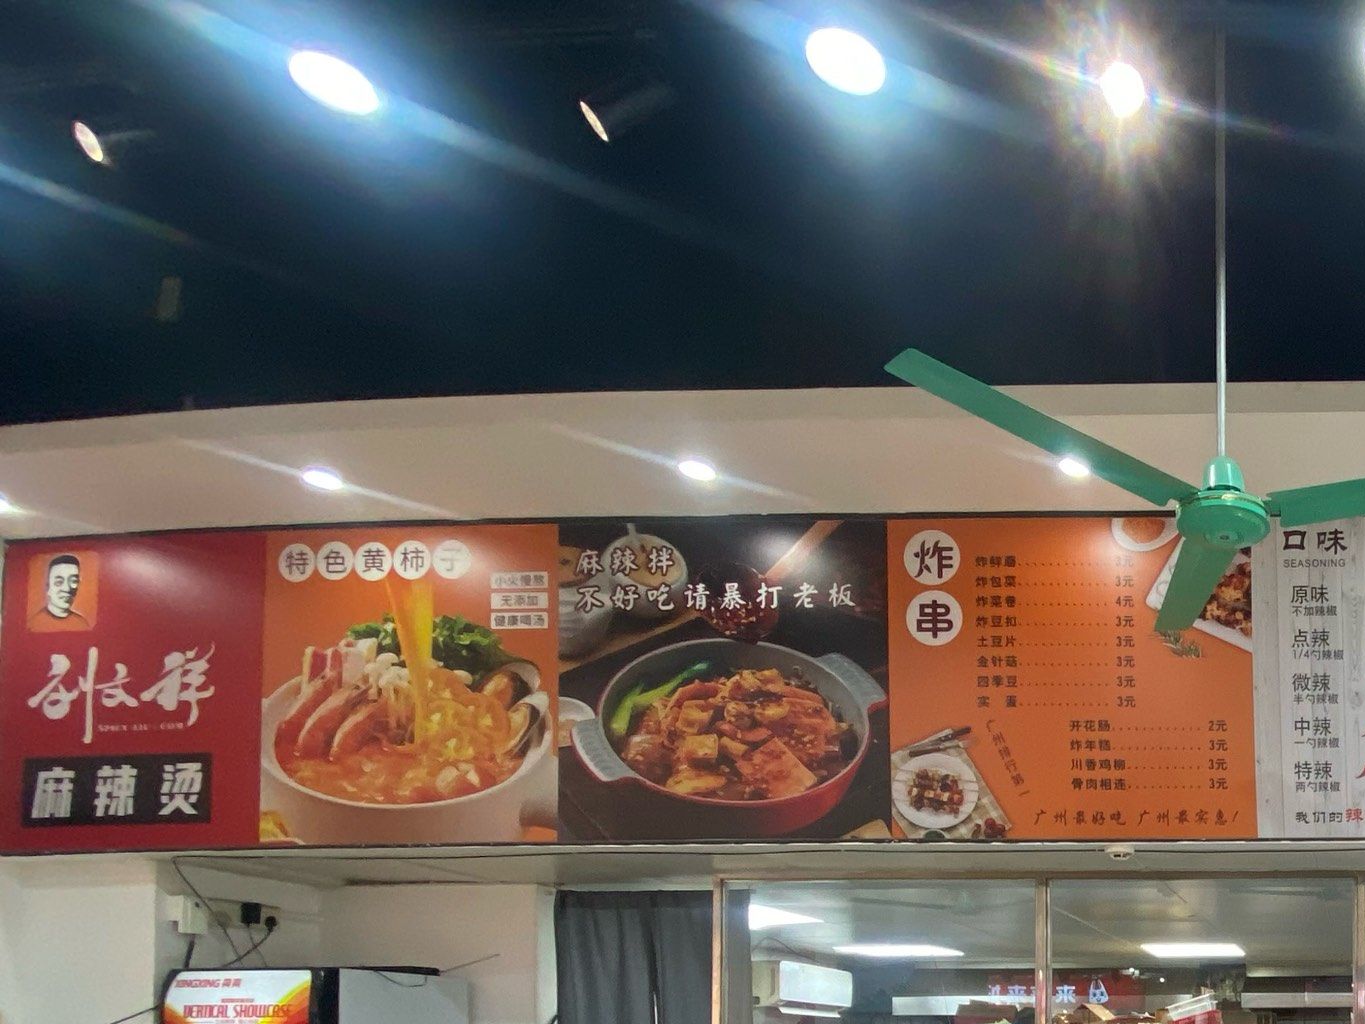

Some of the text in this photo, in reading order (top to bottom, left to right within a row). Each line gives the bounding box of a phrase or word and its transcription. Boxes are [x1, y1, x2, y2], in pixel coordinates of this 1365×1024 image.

[1282, 529, 1348, 555] 口味
[284, 544, 465, 575] 特色黄柿子
[576, 549, 675, 576] 麻辣拌
[1283, 558, 1346, 568] SEASONING
[1115, 576, 1134, 588] 3元
[576, 582, 856, 612] 不好吃请暴打老板
[1291, 584, 1329, 604] 原味
[1115, 596, 1134, 608] 4元
[1291, 605, 1337, 617] 不加辣椒
[1115, 616, 1134, 628] 3元
[977, 636, 1135, 648] 土豆片 3元
[1291, 628, 1331, 648] 点辣
[1292, 649, 1344, 660] 1/4勺辣椒
[977, 656, 1135, 668] 金针菇 3元
[1116, 676, 1136, 688] 3元
[1291, 672, 1331, 692] 微辣
[1117, 696, 1136, 708] 3元
[1294, 693, 1339, 705] 半勺辣椒
[1208, 720, 1228, 732] 2元
[1294, 717, 1331, 736] 中辣
[1209, 740, 1228, 751] 3元
[1294, 737, 1340, 749] 一勺辣椒
[1071, 758, 1228, 771] 川香鸡柳 3元
[1294, 760, 1332, 780] 特辣
[31, 762, 206, 819] 麻辣烫
[1071, 778, 1228, 791] 骨肉相连 3元
[1295, 781, 1340, 793] 两勺辣椒
[1034, 810, 1126, 826] 广州最好吃
[184, 1004, 291, 1018] VERTICAL SHOWCASE
